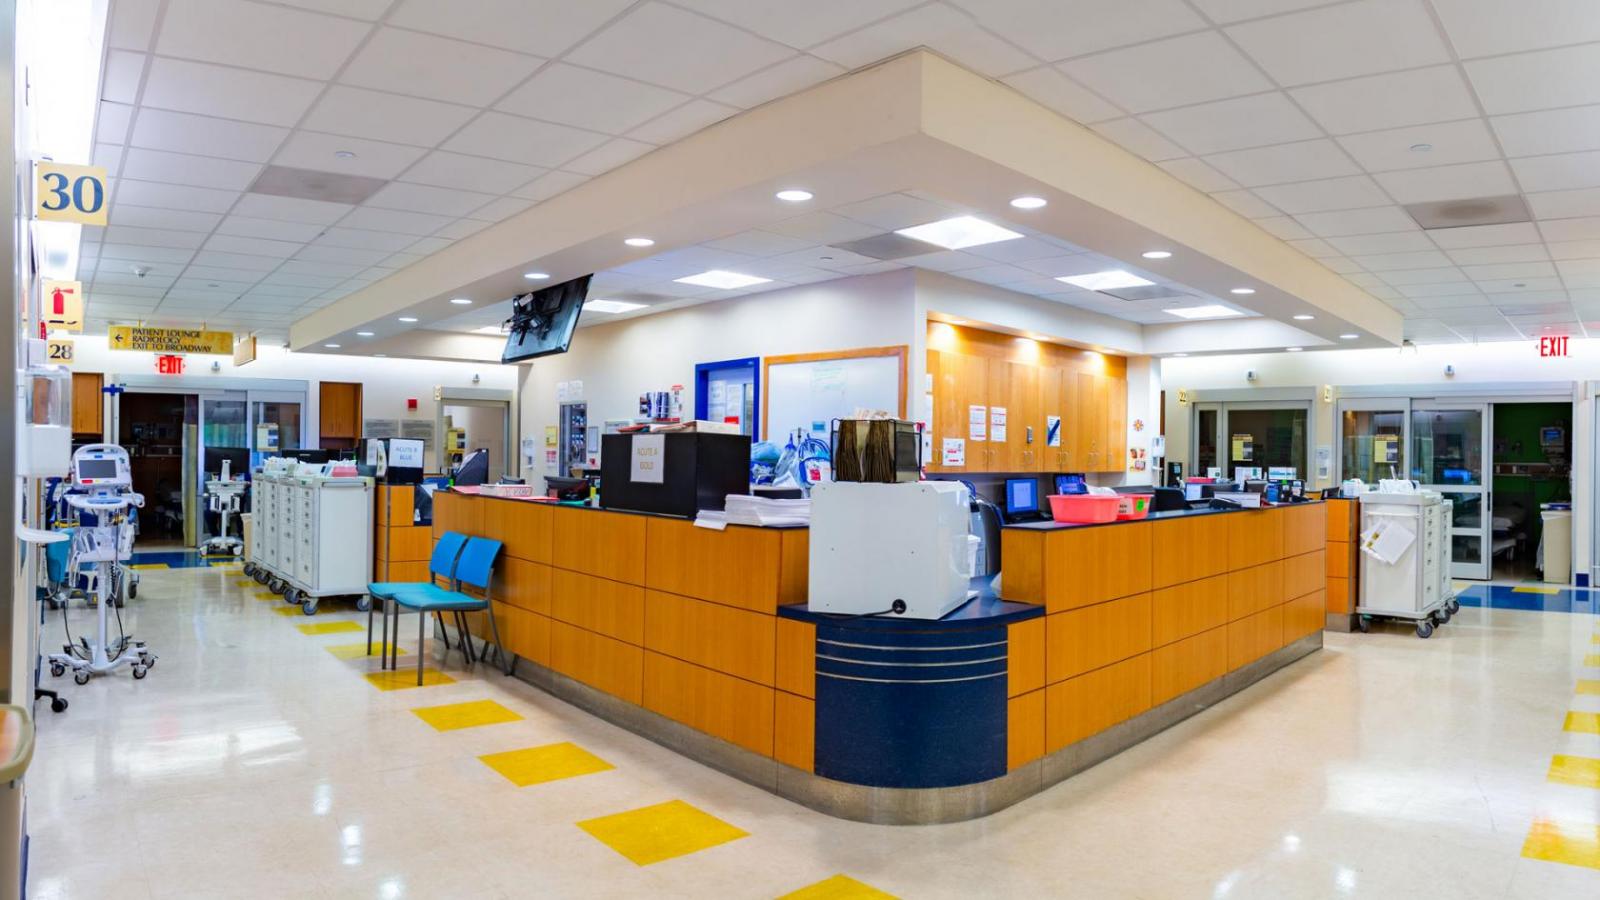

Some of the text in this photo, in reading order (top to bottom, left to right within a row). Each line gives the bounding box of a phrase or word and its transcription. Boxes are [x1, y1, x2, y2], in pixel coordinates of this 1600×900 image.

[41, 172, 104, 213] 30
[132, 328, 200, 338] PATIENT LOUNGE
[132, 335, 182, 344] RADIOLOGY
[49, 343, 73, 360] 28
[132, 342, 213, 353] EXIT TO BROADWAY
[1541, 337, 1569, 357] EXIT
[160, 357, 183, 374] EXIT
